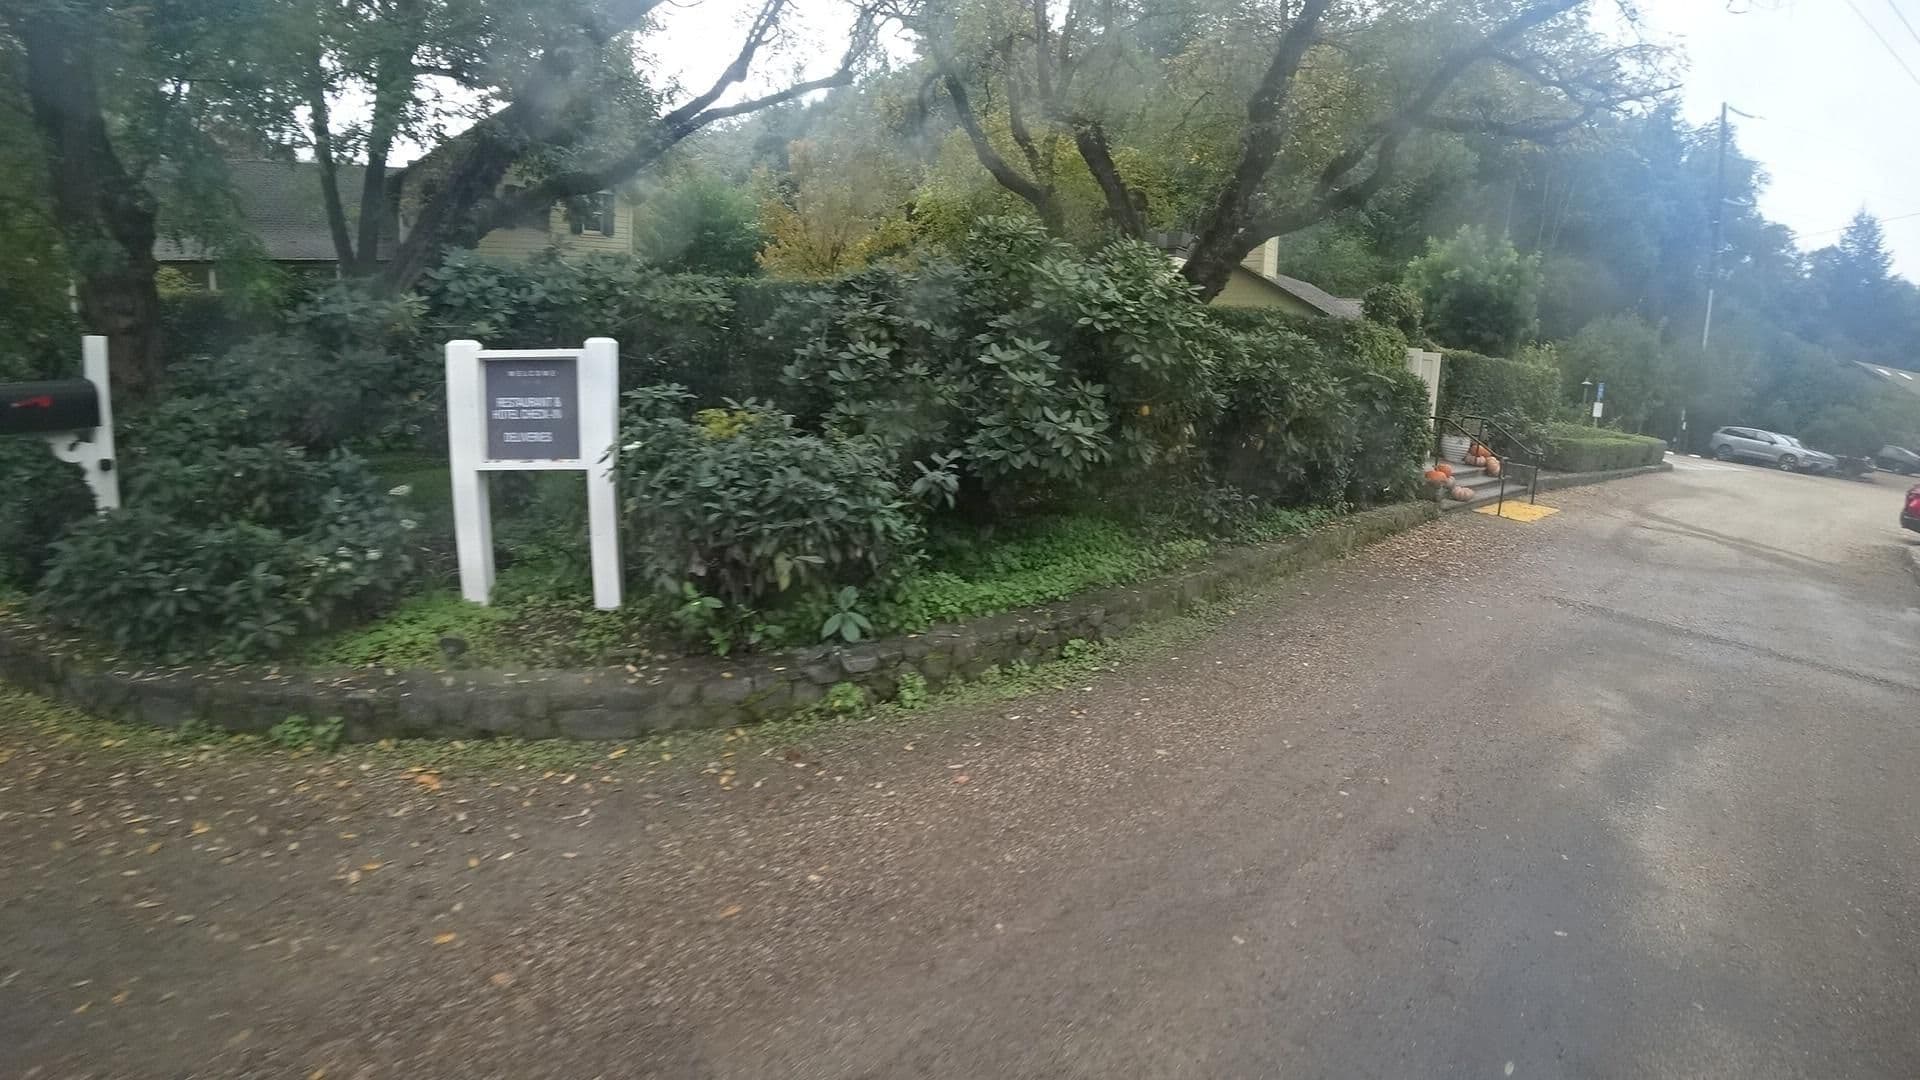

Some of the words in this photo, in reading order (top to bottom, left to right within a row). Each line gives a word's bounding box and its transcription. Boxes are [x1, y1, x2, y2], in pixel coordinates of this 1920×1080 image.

[495, 397, 553, 408] RESTAURANT
[553, 397, 562, 408] &
[492, 409, 520, 420] HOTEL
[503, 432, 553, 443] DELIVERIES
